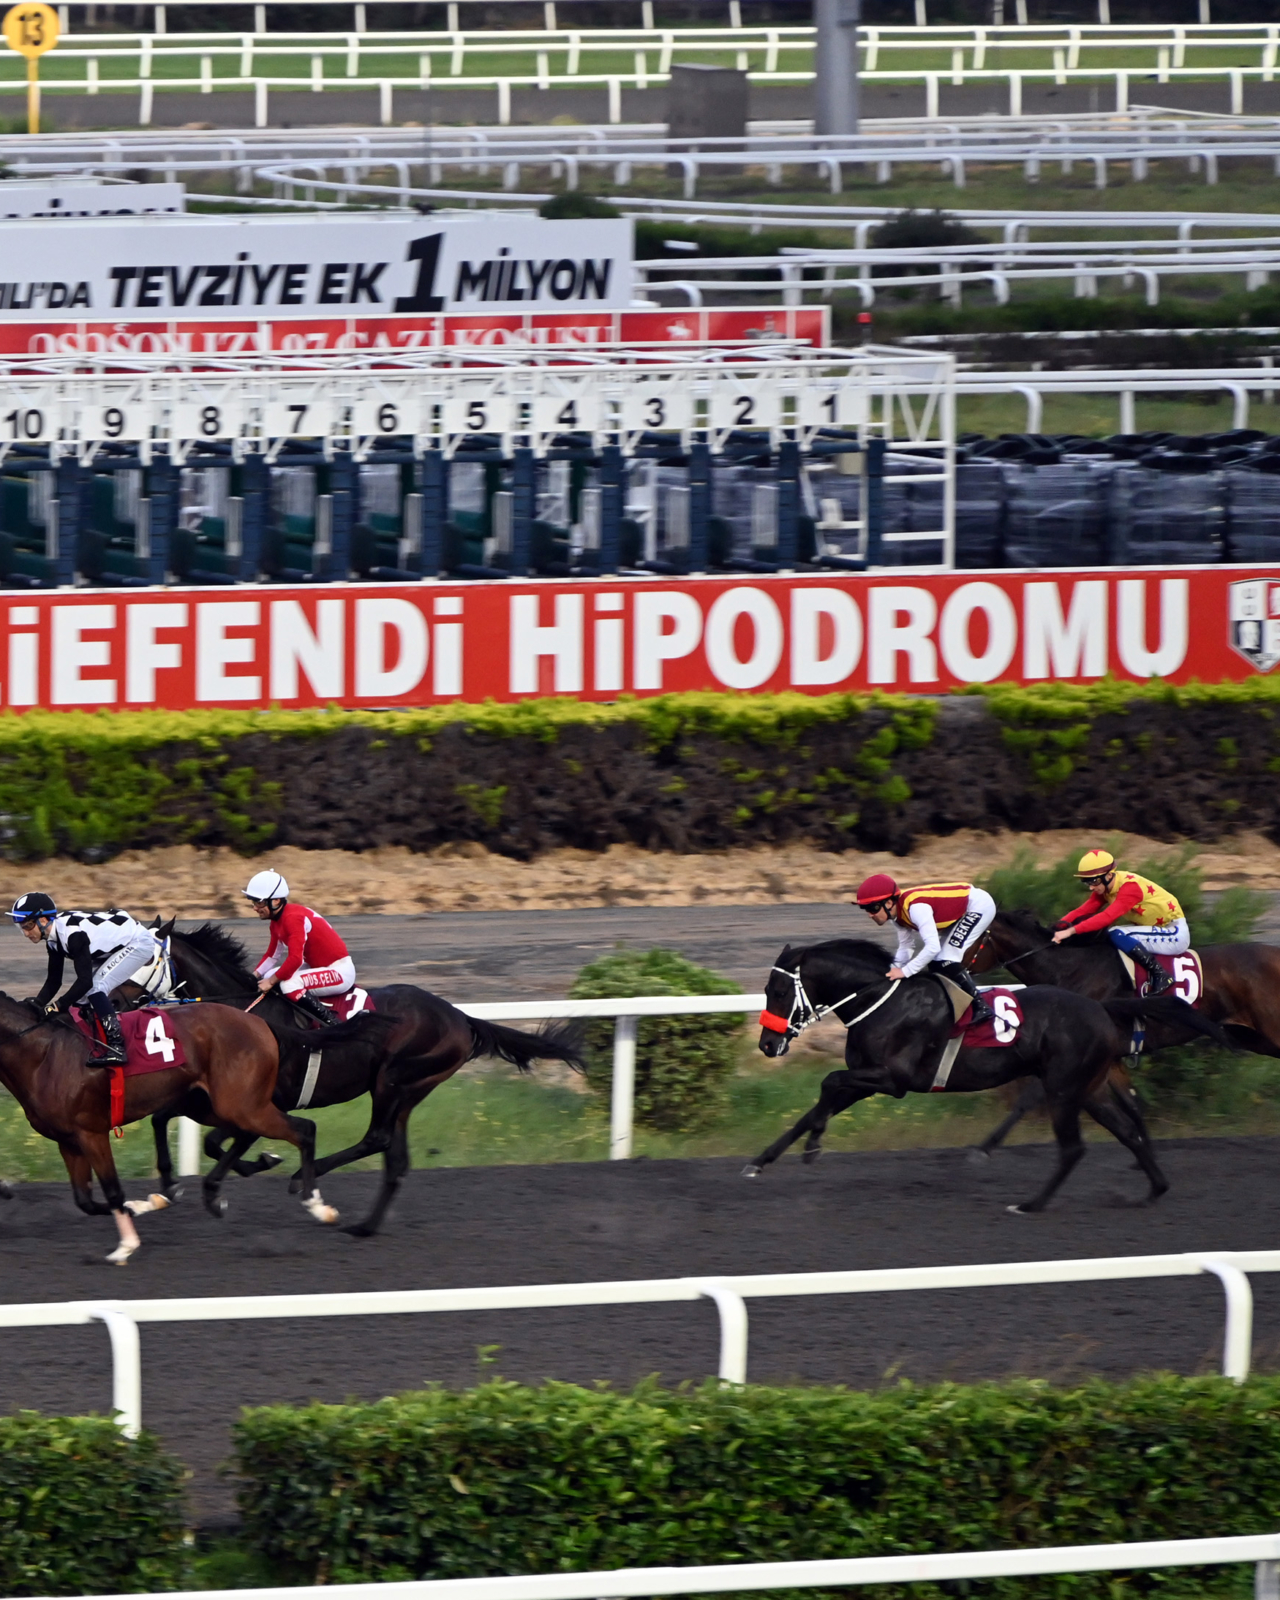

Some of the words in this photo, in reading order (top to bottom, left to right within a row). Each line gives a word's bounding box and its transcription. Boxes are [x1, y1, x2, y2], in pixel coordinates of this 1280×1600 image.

[18, 11, 45, 46] 13
[109, 251, 311, 307] TEVZİYE
[316, 262, 391, 305] EK
[391, 231, 447, 313] 1
[453, 247, 614, 302] MİLYON
[3, 408, 44, 439] 10
[103, 407, 125, 437] 9
[200, 406, 221, 436] 8
[287, 404, 311, 433] 7
[377, 403, 399, 432] 6
[464, 401, 487, 430] 5
[557, 399, 580, 428] 4
[644, 397, 666, 427] 3
[733, 396, 755, 425] 2
[819, 394, 838, 423] 1
[1173, 956, 1200, 1005] 5
[994, 995, 1021, 1043] 6
[145, 1015, 176, 1062] 4
